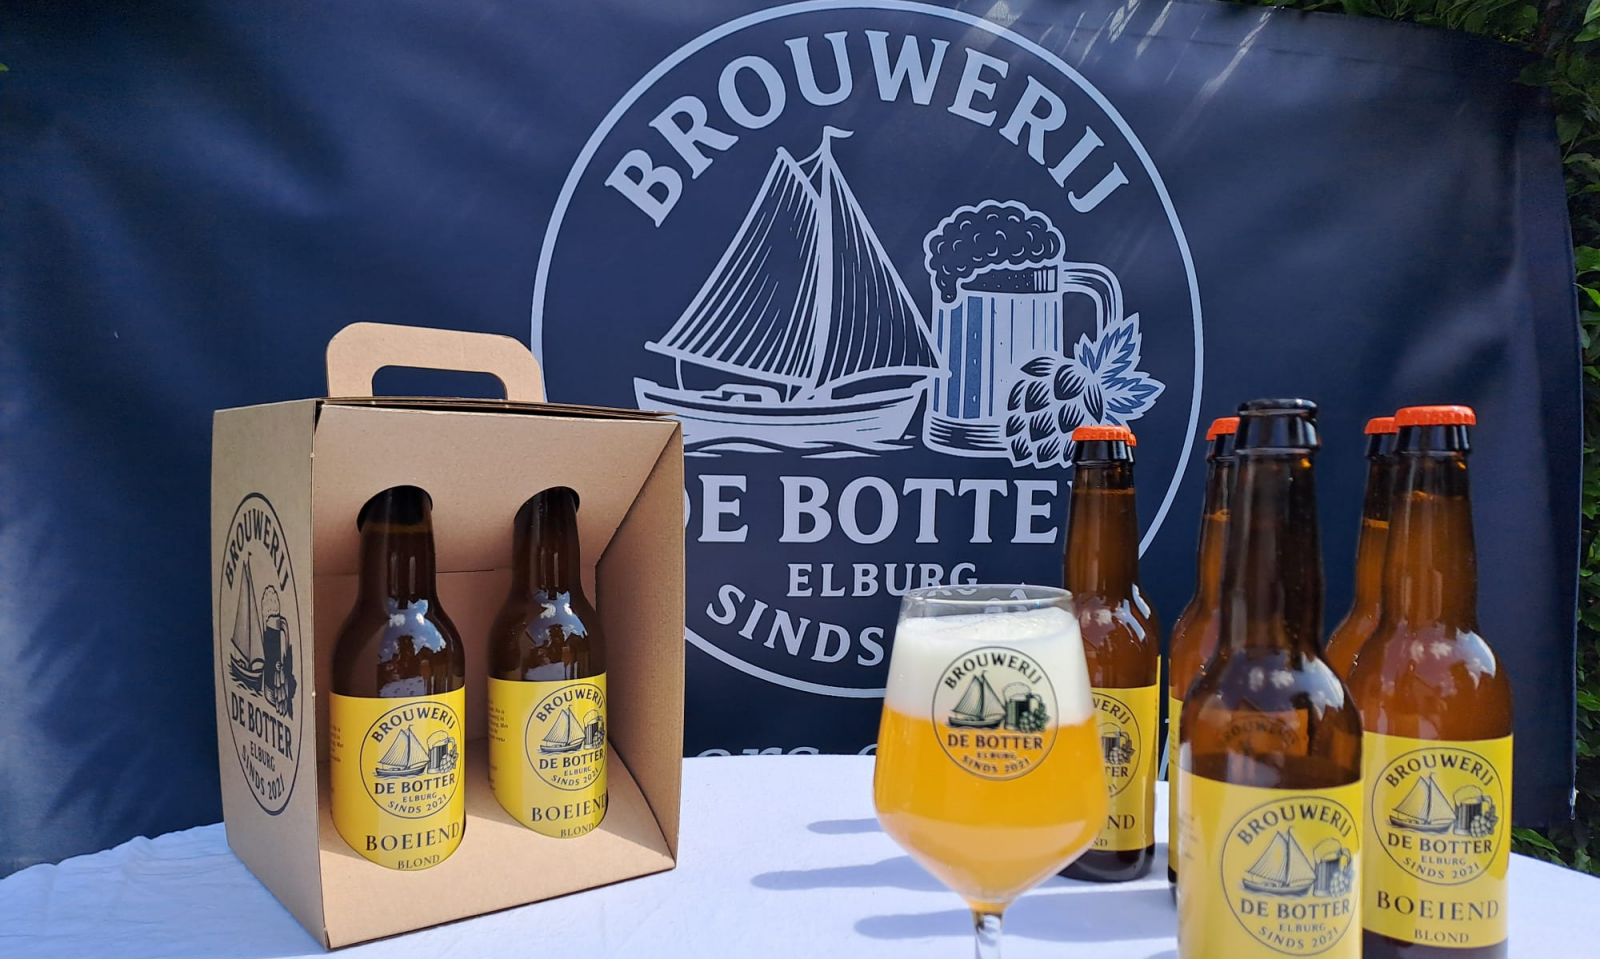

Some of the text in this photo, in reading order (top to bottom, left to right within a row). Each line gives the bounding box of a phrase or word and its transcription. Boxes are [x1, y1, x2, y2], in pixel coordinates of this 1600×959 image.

[604, 30, 1129, 229] BROUWERIJ
[685, 474, 1072, 544] E BOTTE
[225, 508, 289, 591] BROUWERIJ
[786, 562, 978, 597] ELBURG
[706, 584, 885, 667] SINDS
[944, 652, 1042, 690] BROUWERIJ
[536, 688, 604, 722] BROUWERIJ
[231, 691, 246, 728] DE
[247, 701, 293, 761] BOTTER
[371, 707, 456, 744] BROUWERIJ
[947, 733, 1043, 750] DE BOTTER
[250, 741, 276, 772] ELBURG
[539, 748, 604, 770] DE BOTTER
[962, 755, 1030, 773] SINDS 2021
[242, 744, 285, 800] SINDS 2021
[551, 775, 580, 786] SINDS
[1385, 754, 1494, 788] BROUWERIJ
[374, 773, 455, 795] DE BOTTER
[387, 794, 447, 813] SINDS 2021
[402, 793, 437, 803] ELBURG
[560, 823, 595, 838] BLOND
[1237, 803, 1352, 845] BROUWERIJ
[365, 821, 460, 851] BOEIEND
[1387, 832, 1493, 854] DE BOTTER
[397, 854, 440, 870] BLOND
[1403, 857, 1480, 879] SINDS 2021
[1421, 855, 1467, 866] ELBURG
[1240, 898, 1350, 920] DE BOTTER
[1376, 890, 1499, 921] BOEIEND
[1258, 926, 1339, 949] SINDS 2021
[1279, 923, 1326, 932] ELBURG
[1414, 928, 1470, 943] BLOND
